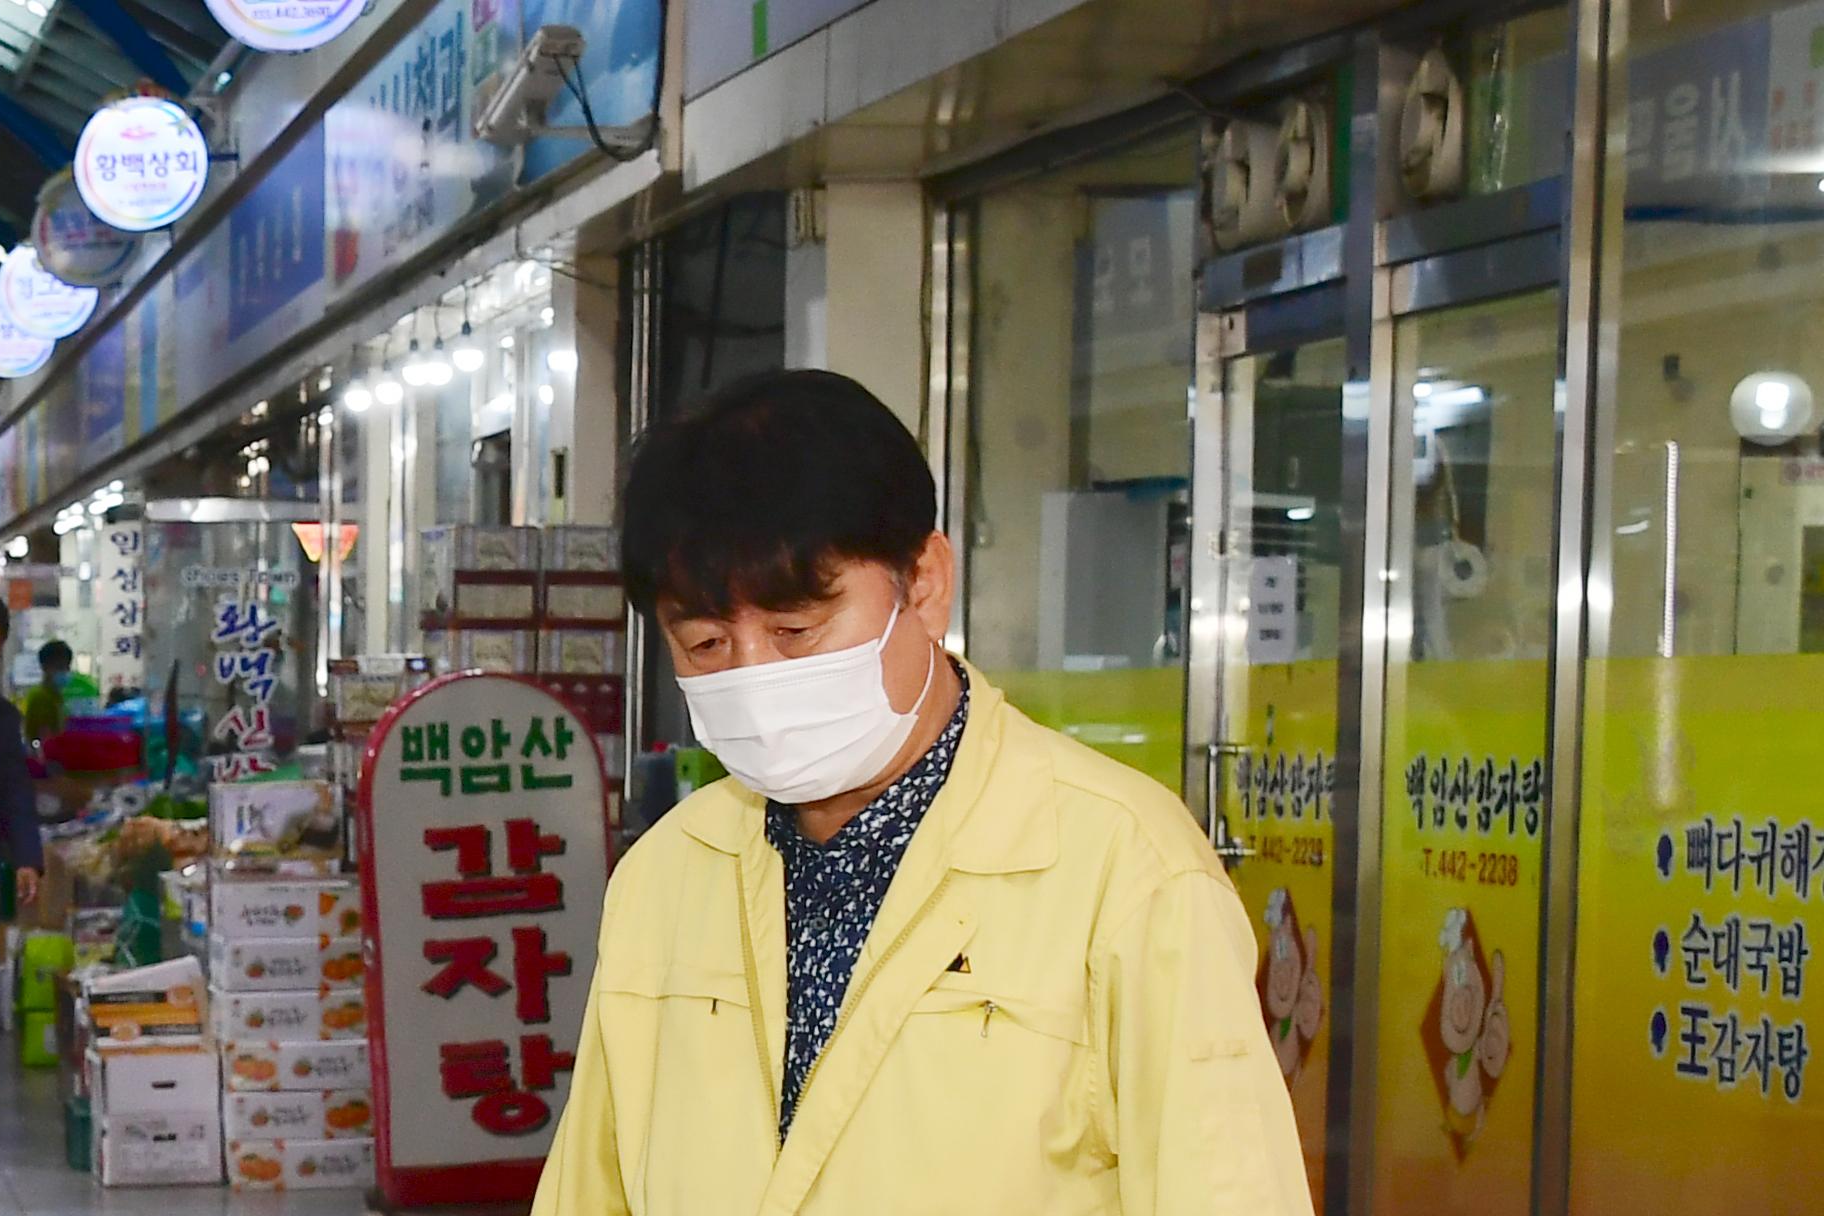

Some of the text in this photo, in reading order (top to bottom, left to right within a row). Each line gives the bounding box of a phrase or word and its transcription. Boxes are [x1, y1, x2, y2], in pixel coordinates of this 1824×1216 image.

[95, 150, 199, 182] 황백상회
[399, 716, 574, 797] 백암산
[420, 817, 576, 1137] 감자탕
[1680, 913, 1809, 997] 순대국밥
